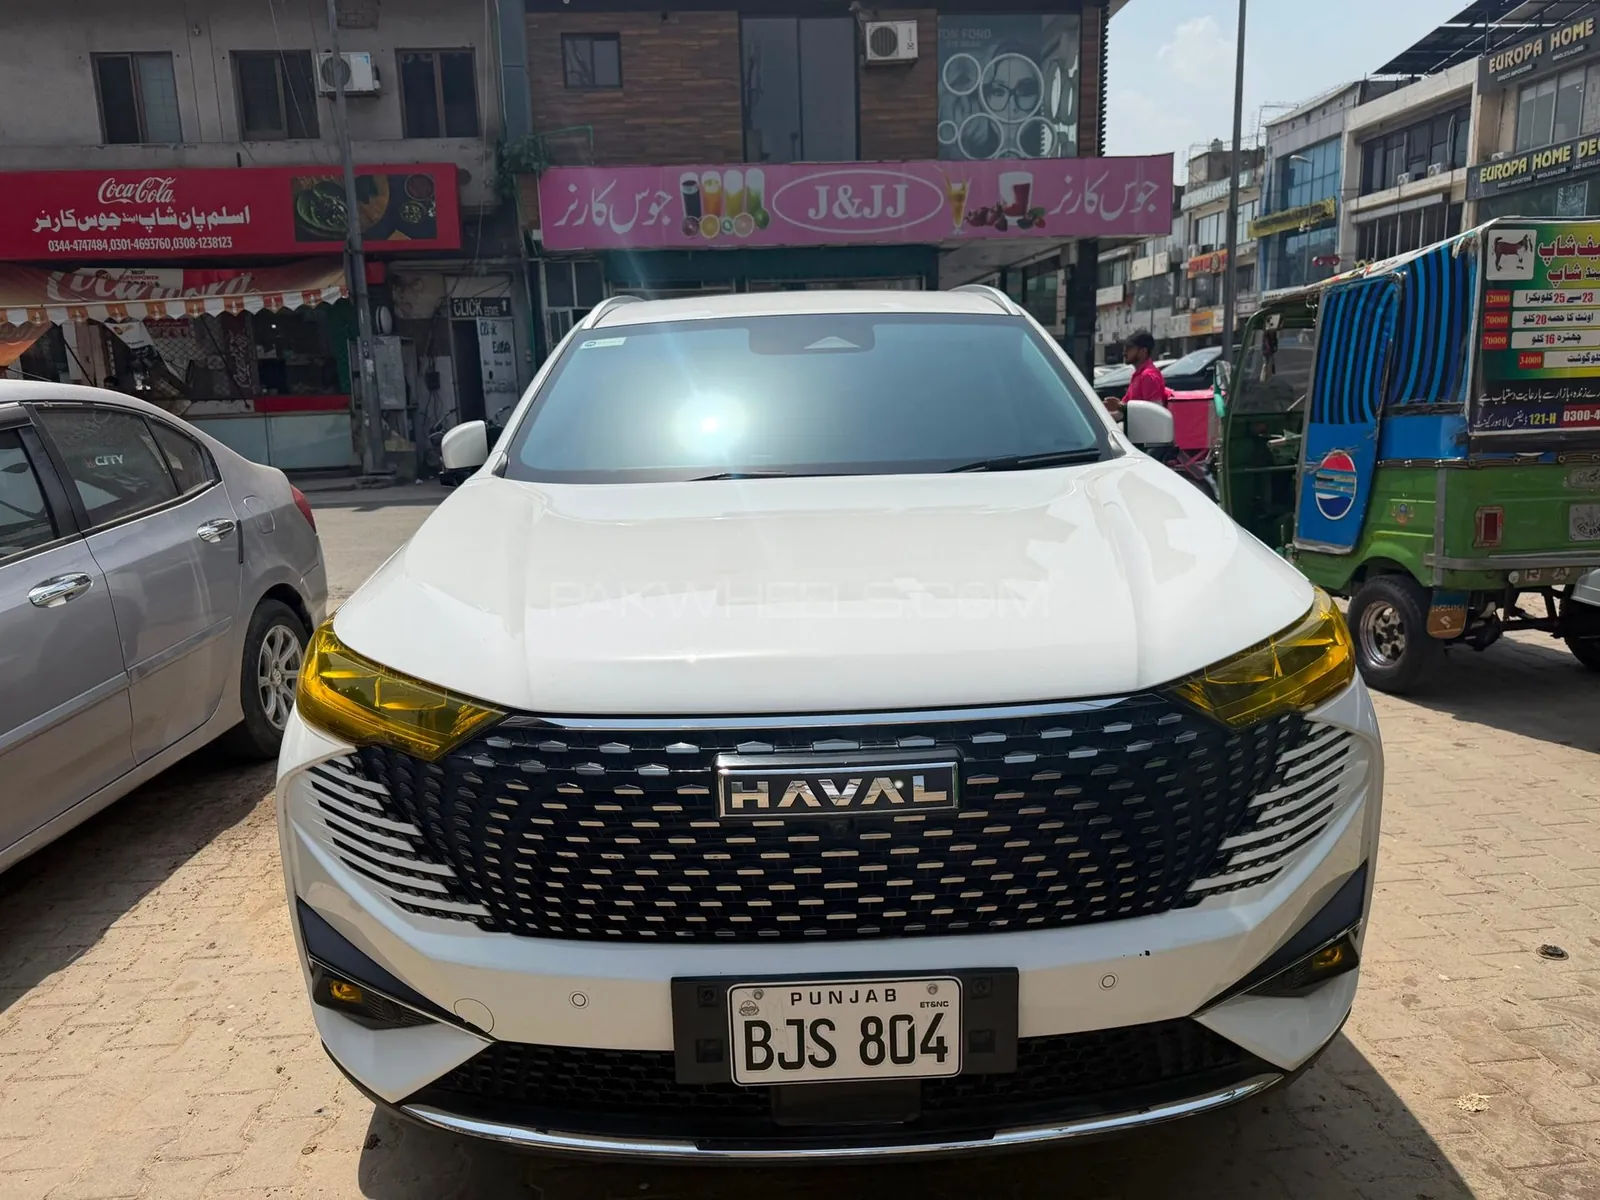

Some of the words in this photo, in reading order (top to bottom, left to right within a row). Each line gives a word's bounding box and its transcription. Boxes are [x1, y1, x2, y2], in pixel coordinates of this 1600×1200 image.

[1488, 38, 1543, 74] EUROPA
[1550, 18, 1595, 51] HOME
[1480, 157, 1528, 183] EUROPA
[1532, 145, 1572, 172] HOME
[553, 178, 617, 227] کارنر
[808, 184, 909, 220] J&JJ
[1048, 170, 1110, 215] کارنر
[1099, 178, 1160, 222] جوس
[33, 208, 76, 233] کارنر
[77, 211, 122, 231] جوس
[138, 206, 180, 233] شاپ
[179, 205, 206, 232] پان
[206, 205, 250, 231] اسلم
[609, 187, 674, 234] جوس
[1537, 233, 1577, 267] شاپ
[1547, 263, 1583, 288] شاپ
[454, 298, 483, 317] CLICK
[1553, 292, 1565, 304] 25
[1582, 292, 1594, 303] 23
[1535, 314, 1547, 325] 20
[1544, 334, 1555, 345] 16
[1529, 412, 1557, 425] 121-H
[95, 454, 124, 466] CITY
[730, 774, 948, 809] HAVAL
[790, 988, 898, 1006] PUNJAB
[919, 1000, 950, 1009] ET&NC
[744, 1018, 838, 1072] BJS
[859, 1012, 949, 1067] 804
